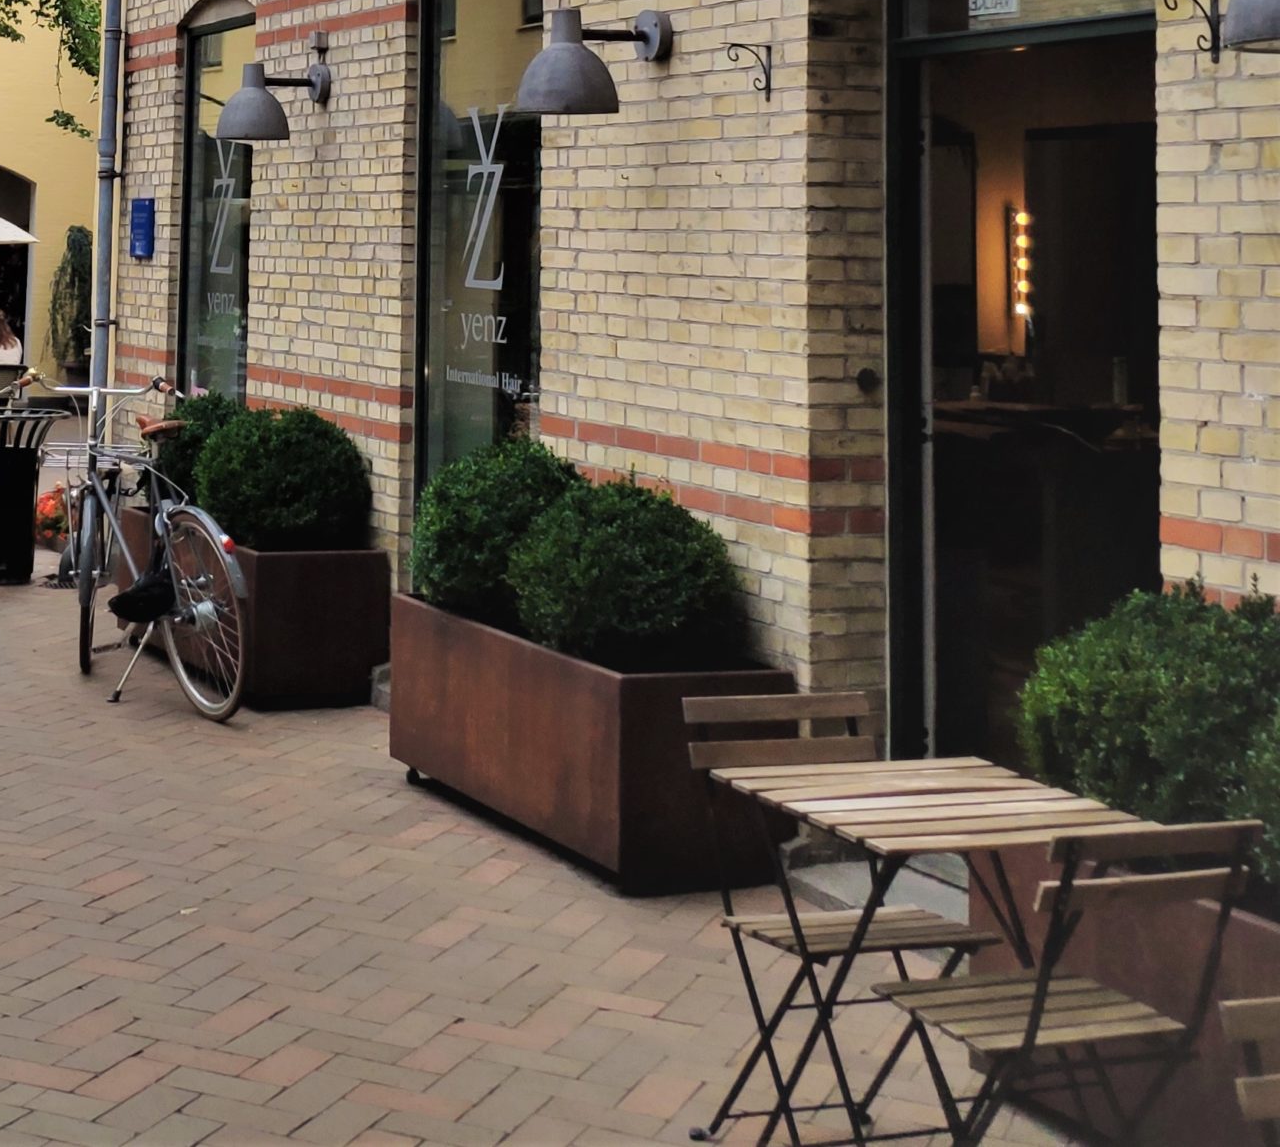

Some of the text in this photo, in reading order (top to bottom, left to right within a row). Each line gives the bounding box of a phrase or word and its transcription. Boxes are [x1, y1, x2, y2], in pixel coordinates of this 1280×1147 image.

[207, 292, 236, 321] yenz
[461, 313, 508, 350] yenz
[446, 364, 522, 394] International Hair
